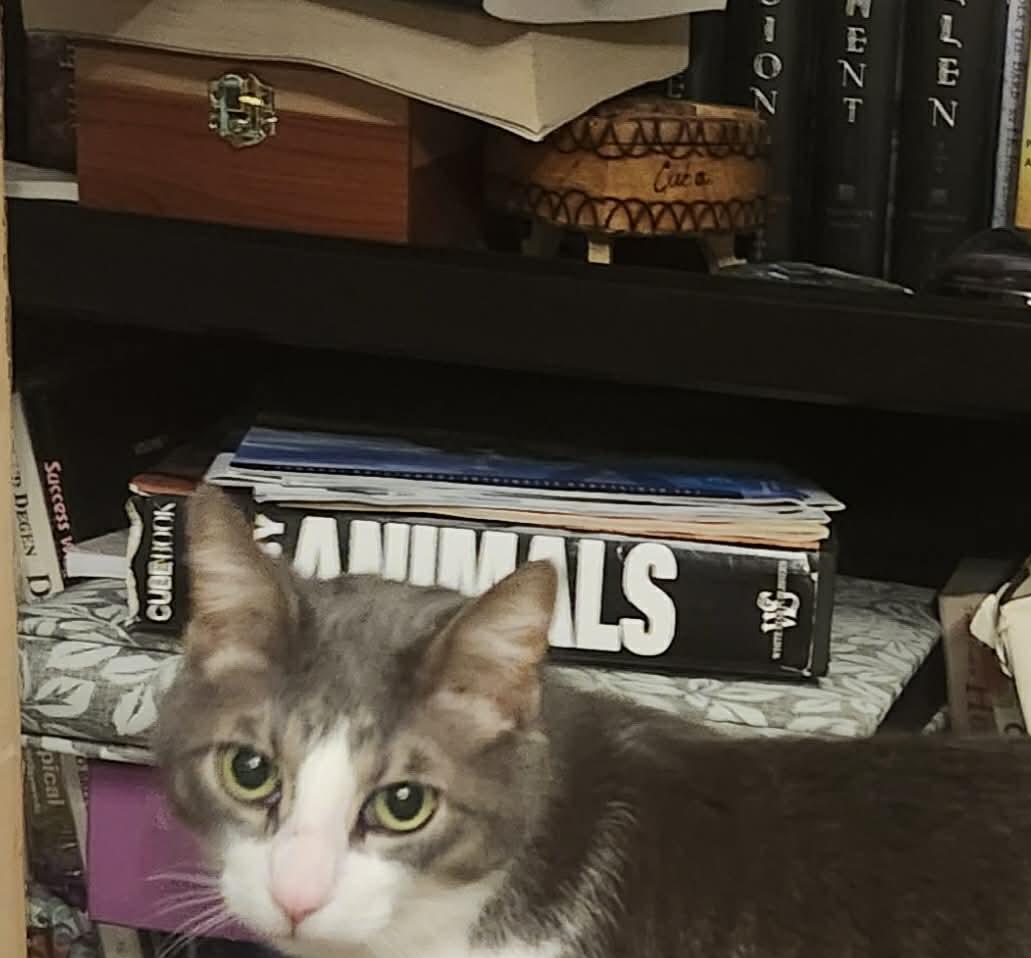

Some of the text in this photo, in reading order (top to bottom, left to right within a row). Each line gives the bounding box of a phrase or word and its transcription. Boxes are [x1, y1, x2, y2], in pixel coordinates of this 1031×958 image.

[14, 493, 38, 557] DEGEN
[44, 460, 70, 531] Success
[292, 514, 677, 656] ANIMALS
